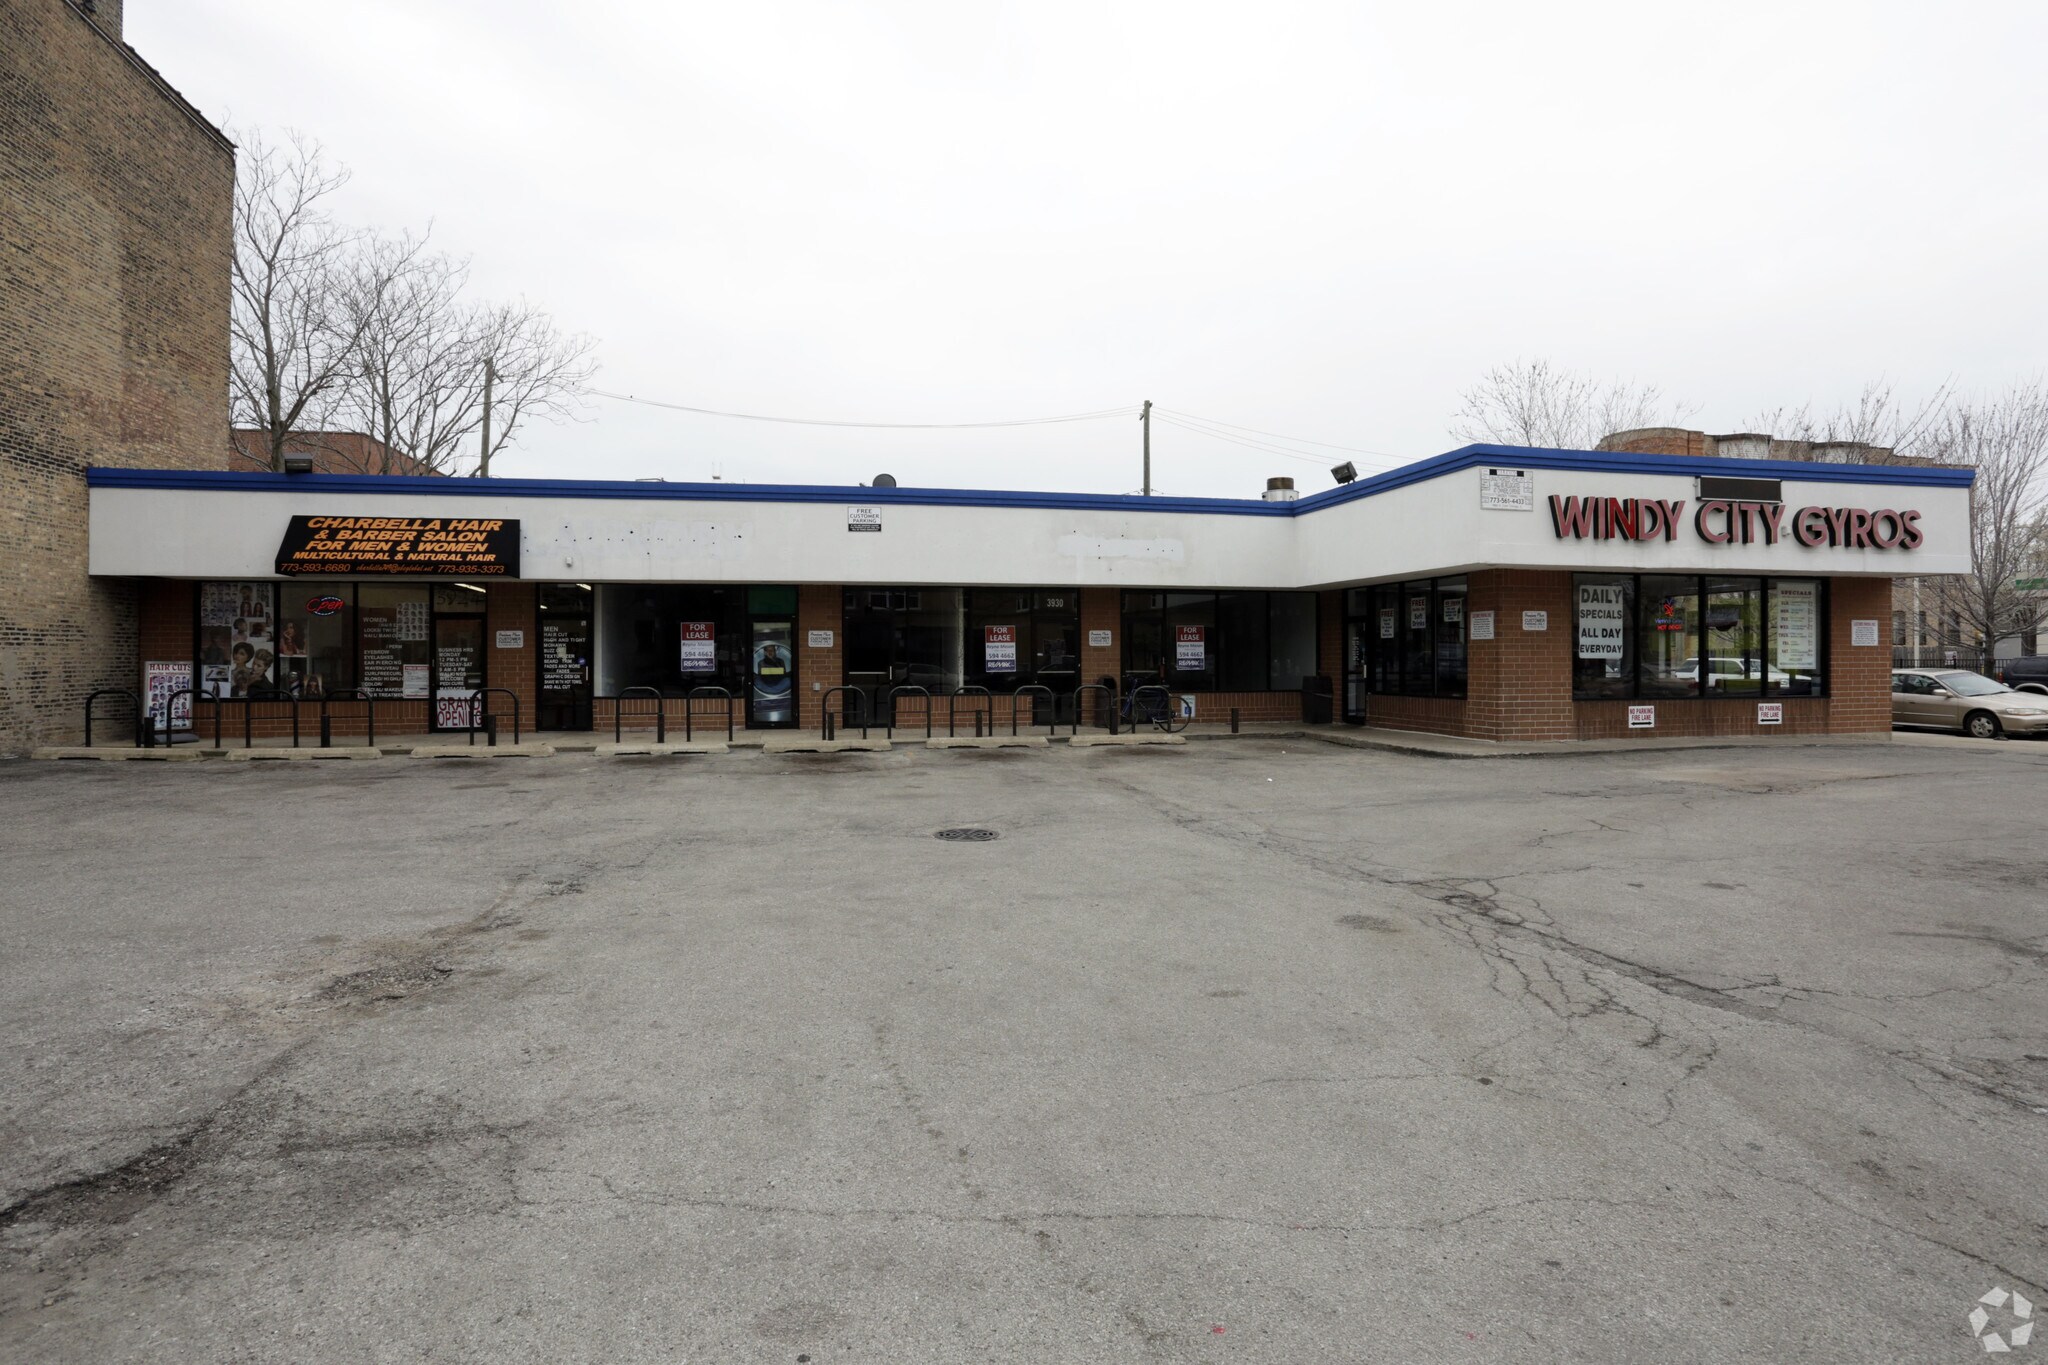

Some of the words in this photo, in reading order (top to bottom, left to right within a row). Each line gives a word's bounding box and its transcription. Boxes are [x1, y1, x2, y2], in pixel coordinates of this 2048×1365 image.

[307, 516, 441, 531] CHARBELLA
[447, 520, 503, 531] HAIR
[1549, 494, 1686, 541] WINDY
[1694, 500, 1785, 545] CITY
[1792, 506, 1923, 550] GYROS
[314, 529, 329, 540] &
[335, 530, 417, 541] BARBER
[420, 532, 487, 542] SALON
[305, 541, 343, 550] FOR
[348, 542, 395, 551] MEN
[396, 542, 411, 552] &
[417, 542, 489, 552] WOMEN
[292, 551, 390, 560] MULTICULTURAL
[394, 552, 404, 560] &
[407, 552, 462, 562] NATURAL
[466, 554, 496, 562] HAIR
[280, 563, 350, 572] 773-593-6680
[438, 564, 504, 574] 773-935-3373
[1581, 588, 1622, 604] DAILY
[306, 597, 344, 613] Open
[1046, 598, 1064, 607] 3930
[1580, 609, 1622, 619] SPECIALS
[1581, 628, 1598, 638] ALL
[1602, 628, 1621, 638] DAY
[1580, 645, 1622, 653] EVERYDAY
